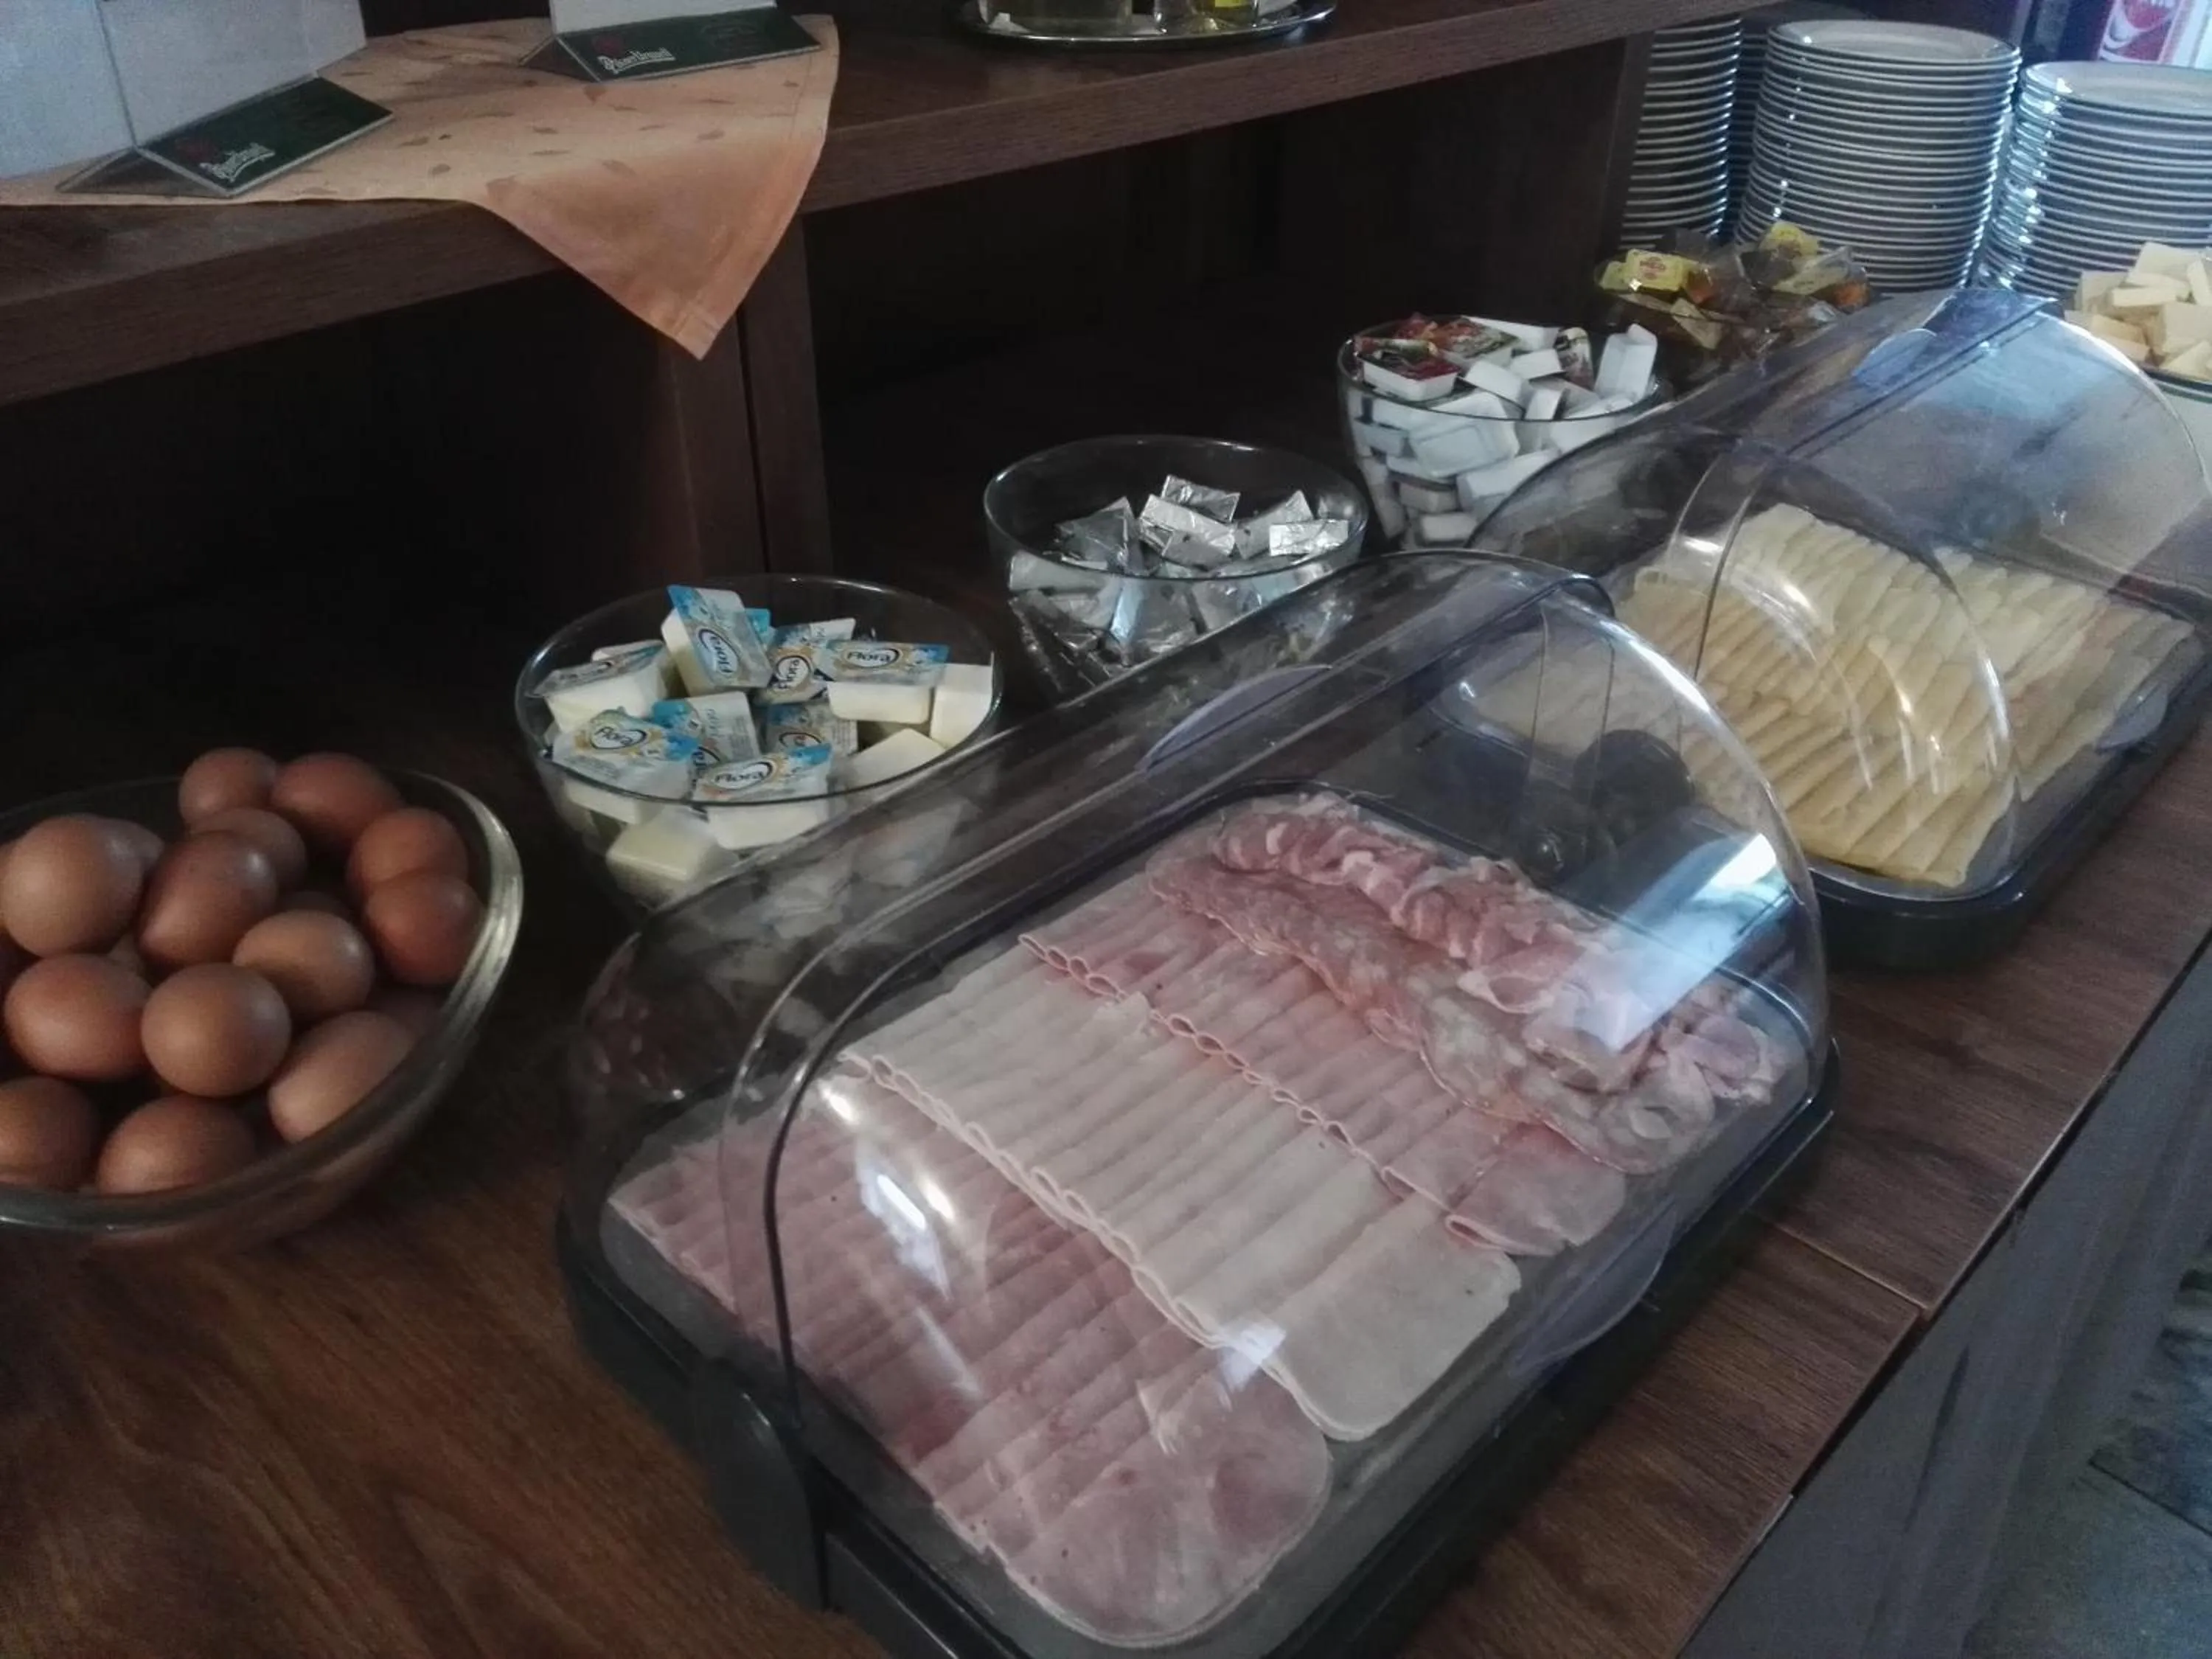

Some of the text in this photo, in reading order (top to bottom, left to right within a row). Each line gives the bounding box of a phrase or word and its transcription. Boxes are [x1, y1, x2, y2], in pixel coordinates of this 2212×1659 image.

[710, 636, 734, 674] Flora
[847, 651, 891, 663] Flora
[594, 726, 633, 747] Flora
[712, 771, 764, 784] Flora
